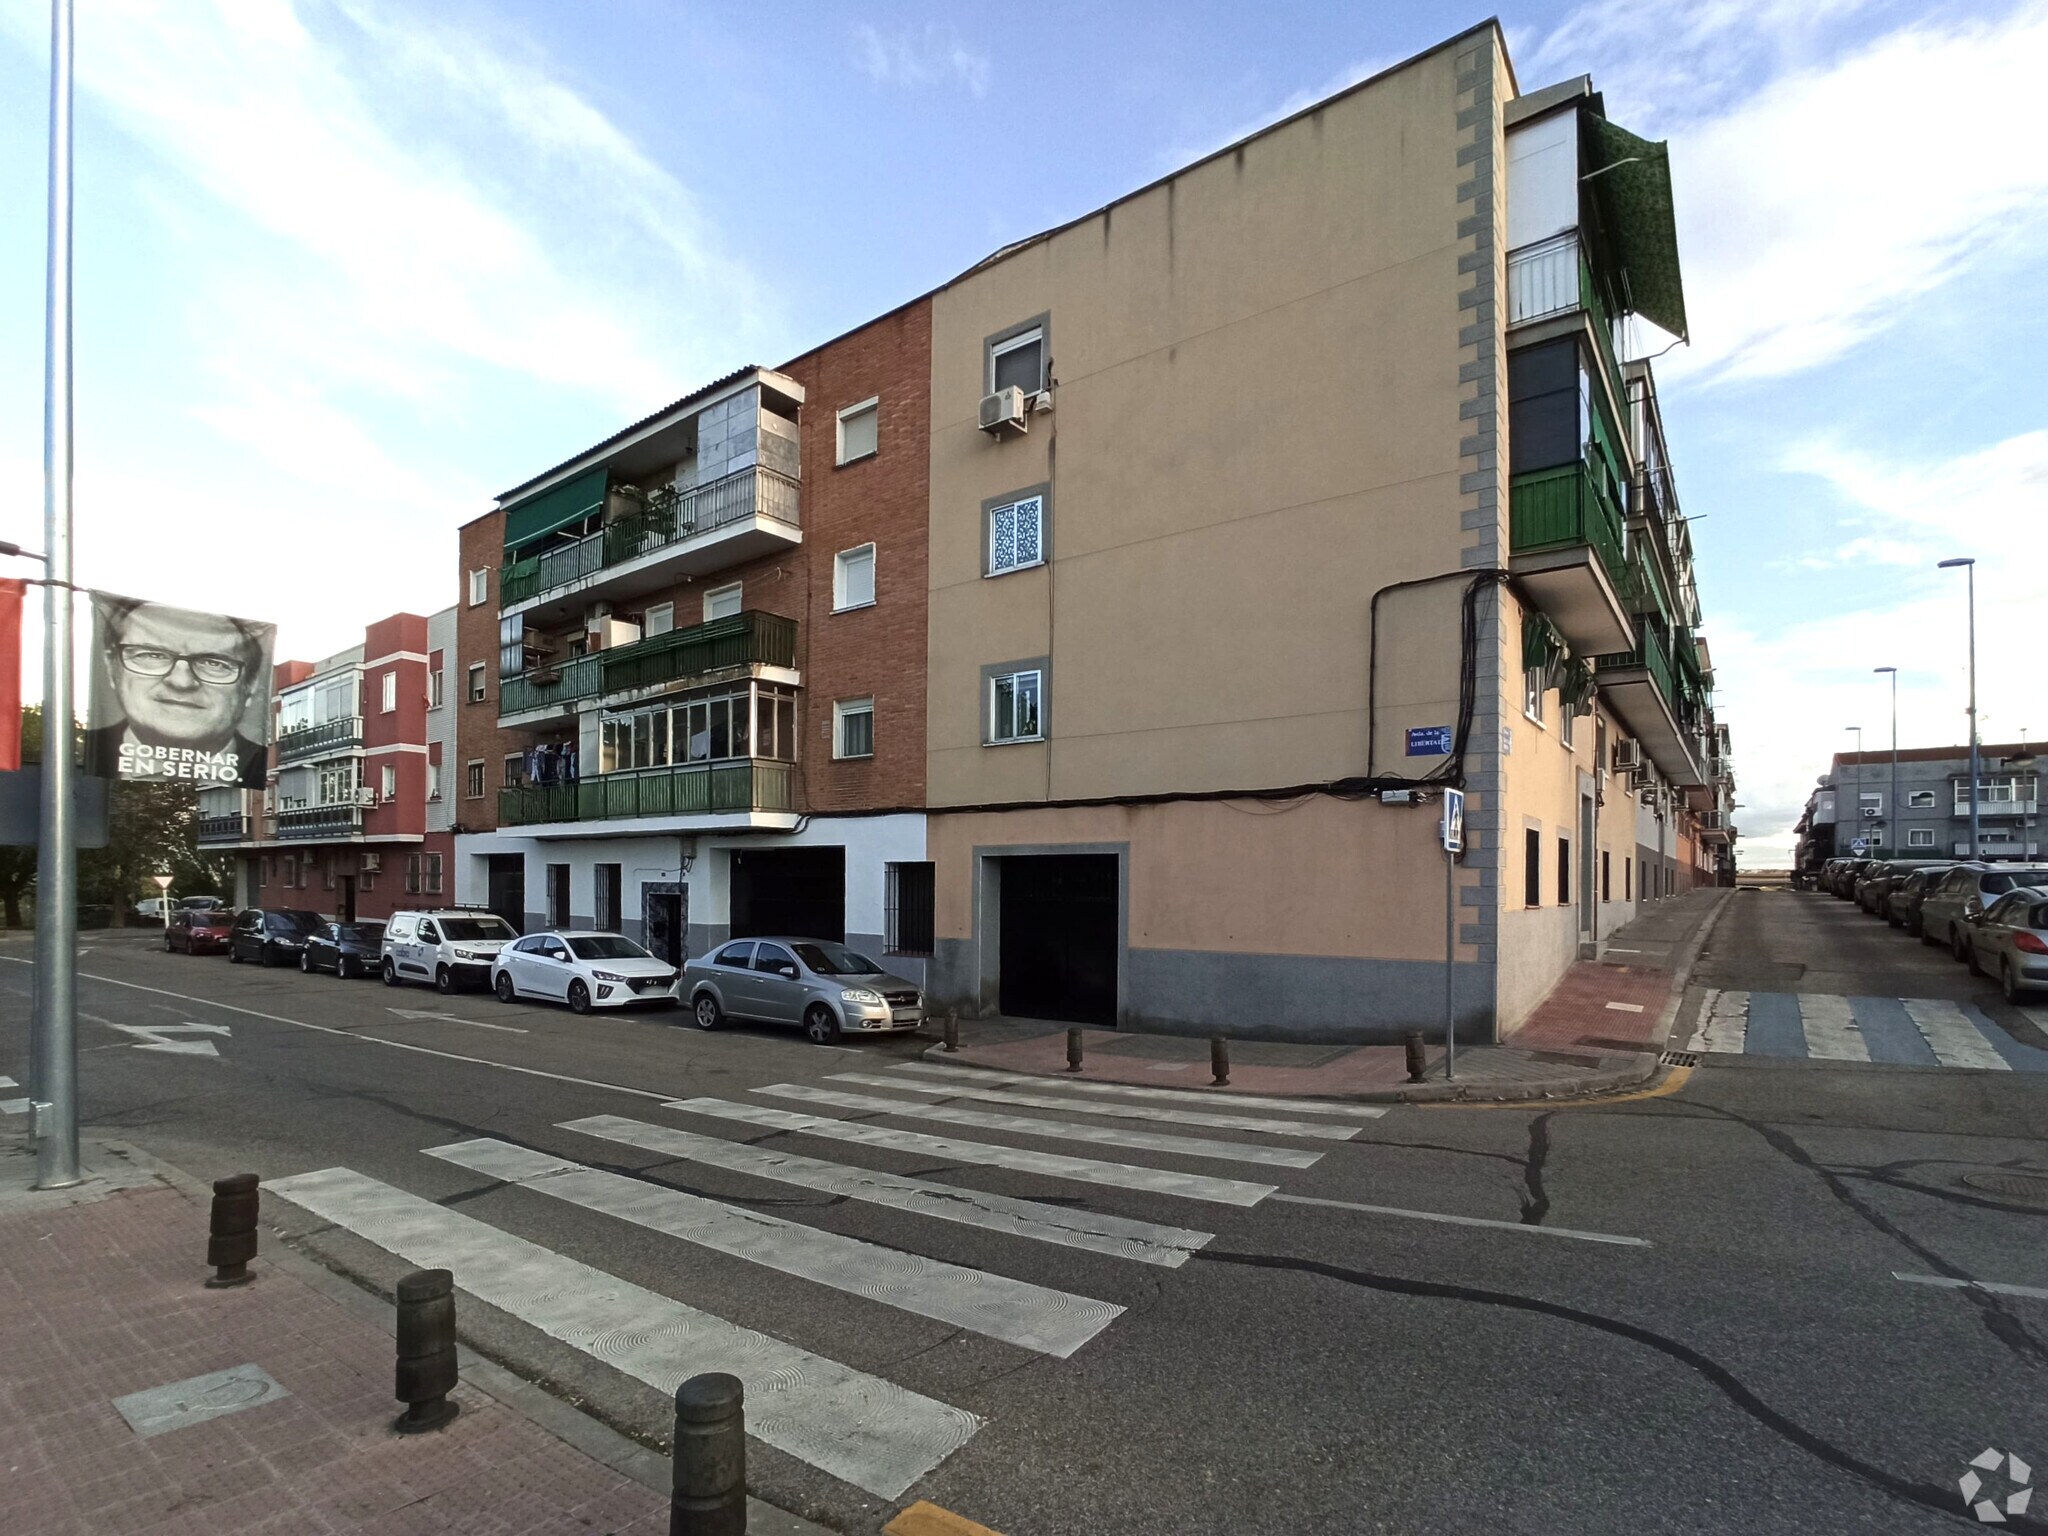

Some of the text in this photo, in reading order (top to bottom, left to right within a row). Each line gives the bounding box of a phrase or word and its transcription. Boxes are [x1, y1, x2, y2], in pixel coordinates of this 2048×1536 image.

[119, 743, 239, 766] GOBERNAR
[118, 756, 243, 783] EN SERIO.
